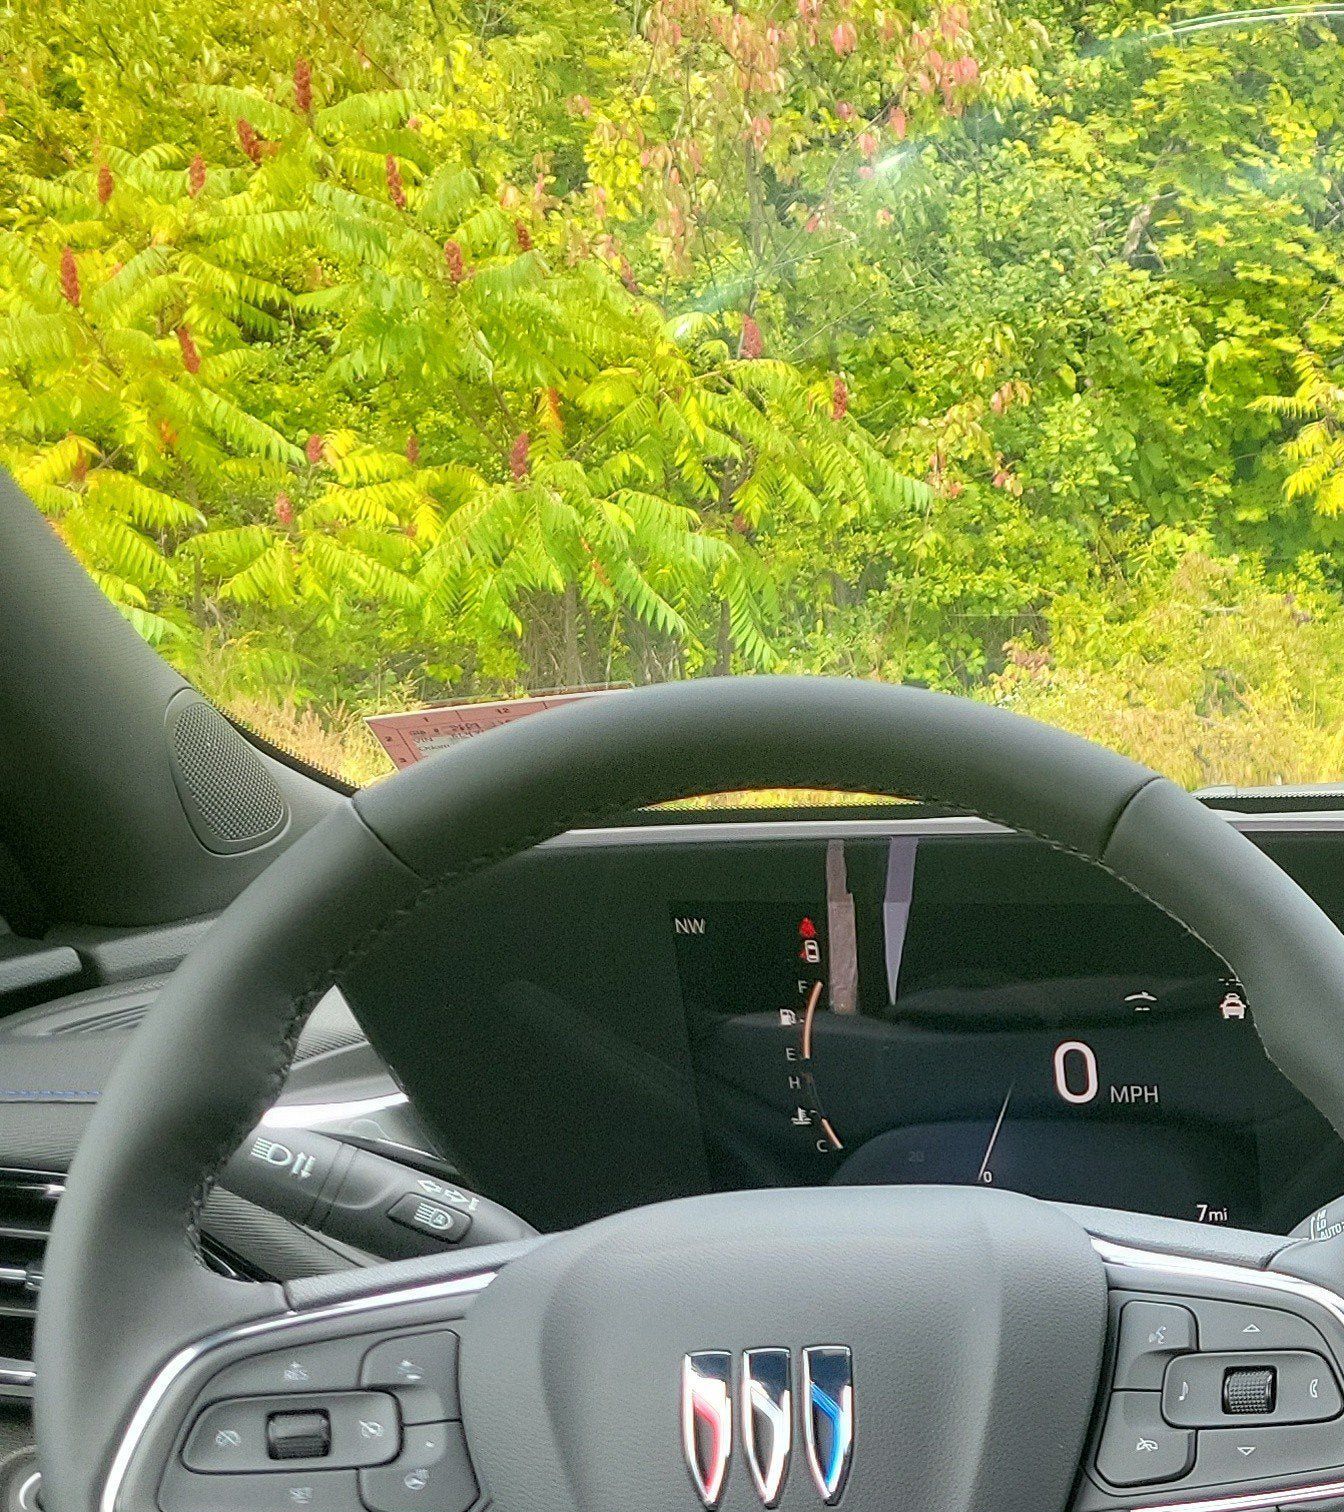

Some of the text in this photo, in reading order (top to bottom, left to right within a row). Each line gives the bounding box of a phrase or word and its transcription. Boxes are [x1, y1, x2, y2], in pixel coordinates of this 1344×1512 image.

[675, 918, 705, 934] NW
[798, 980, 807, 993] F
[786, 1048, 797, 1061] E
[1055, 1041, 1159, 1103] 0 MPH
[789, 1076, 800, 1089] H
[816, 1140, 828, 1152] C
[983, 1171, 992, 1183] 0
[1316, 1219, 1327, 1231] LO
[1320, 1223, 1342, 1239] AUTO
